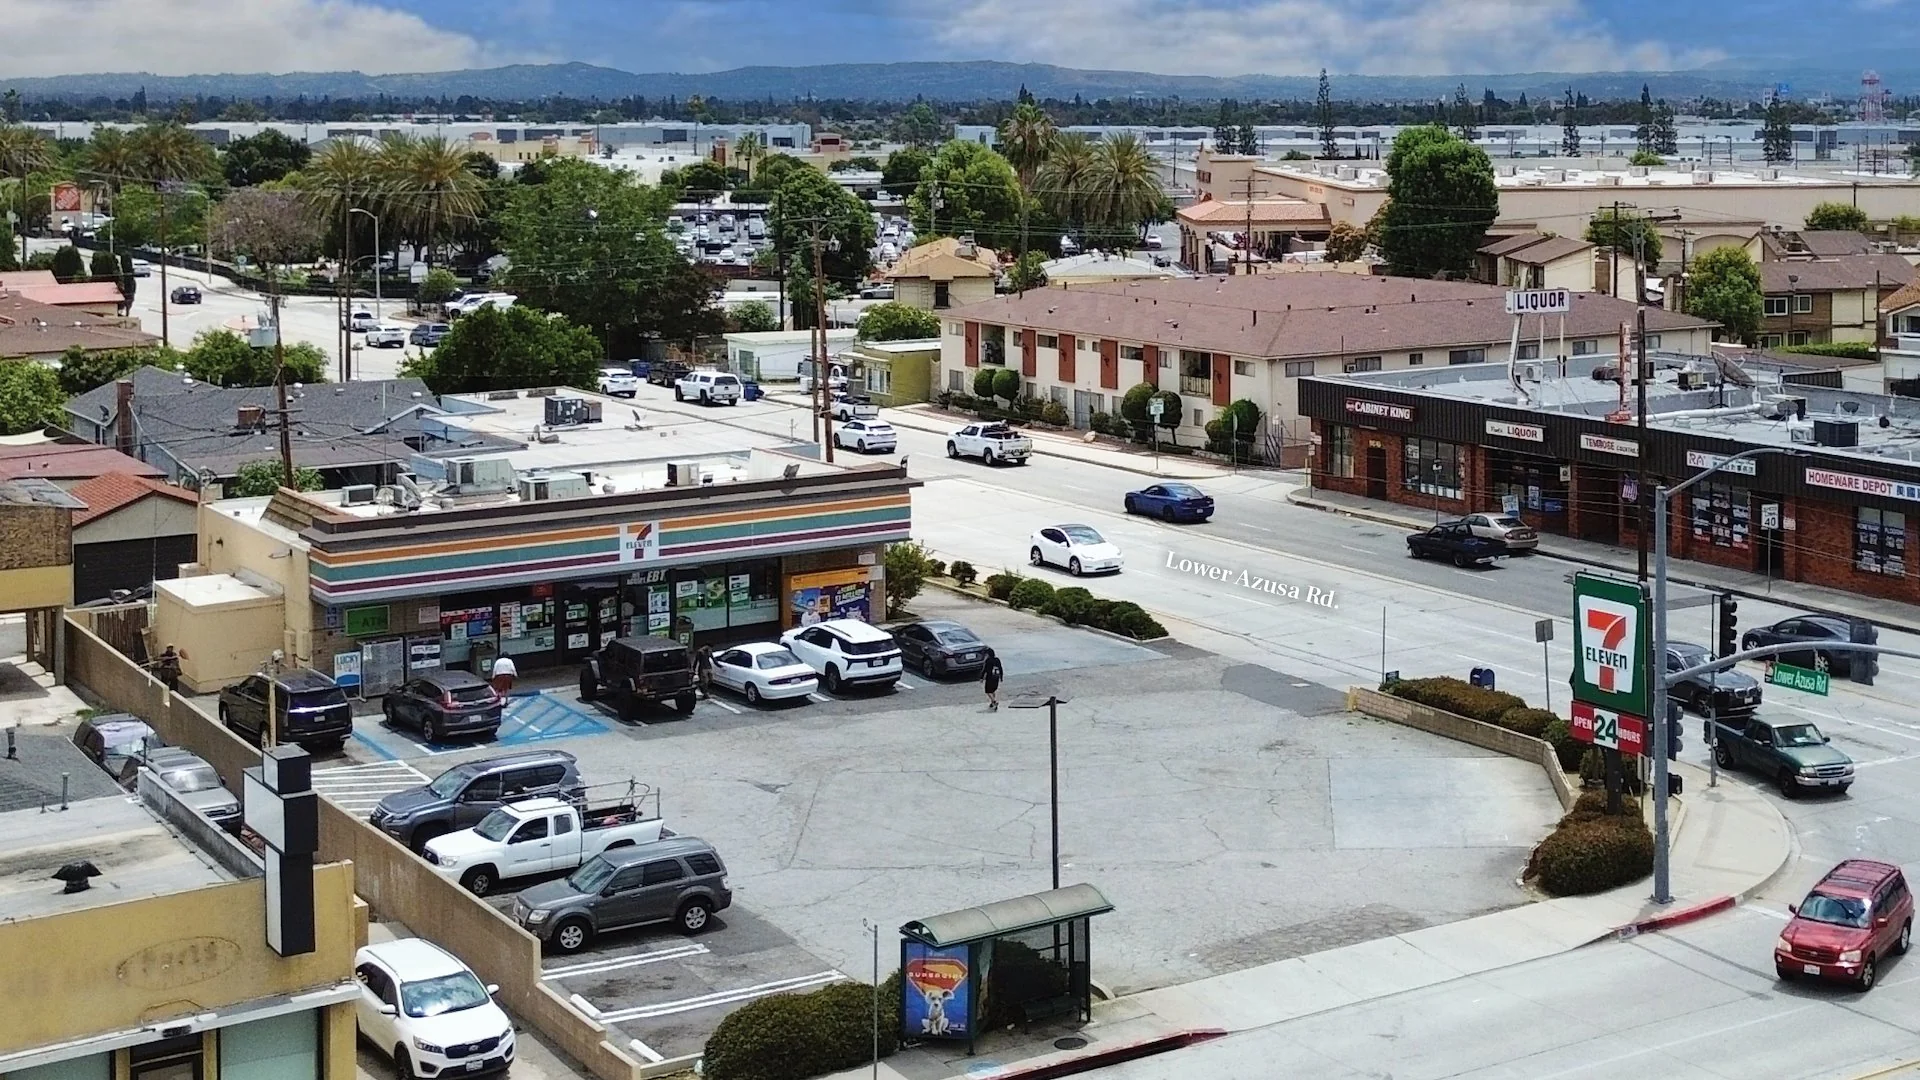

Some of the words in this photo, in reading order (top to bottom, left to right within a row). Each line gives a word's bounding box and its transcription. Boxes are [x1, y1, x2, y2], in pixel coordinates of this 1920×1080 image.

[1517, 291, 1565, 311] LIQUOR
[1354, 401, 1390, 417] CABINET
[1390, 405, 1410, 420] KING
[1507, 425, 1538, 439] LIQUOR
[1808, 471, 1860, 490] HOMEWARE
[1862, 478, 1893, 496] DEPOT
[1764, 517, 1776, 527] 40
[646, 570, 666, 583] EBT
[1773, 665, 1795, 685] Lower
[1794, 670, 1816, 690] Azusa
[1816, 674, 1827, 693] Rd
[1573, 715, 1593, 728] OPEN
[1594, 714, 1618, 744] 24
[1618, 725, 1641, 744] HOURS
